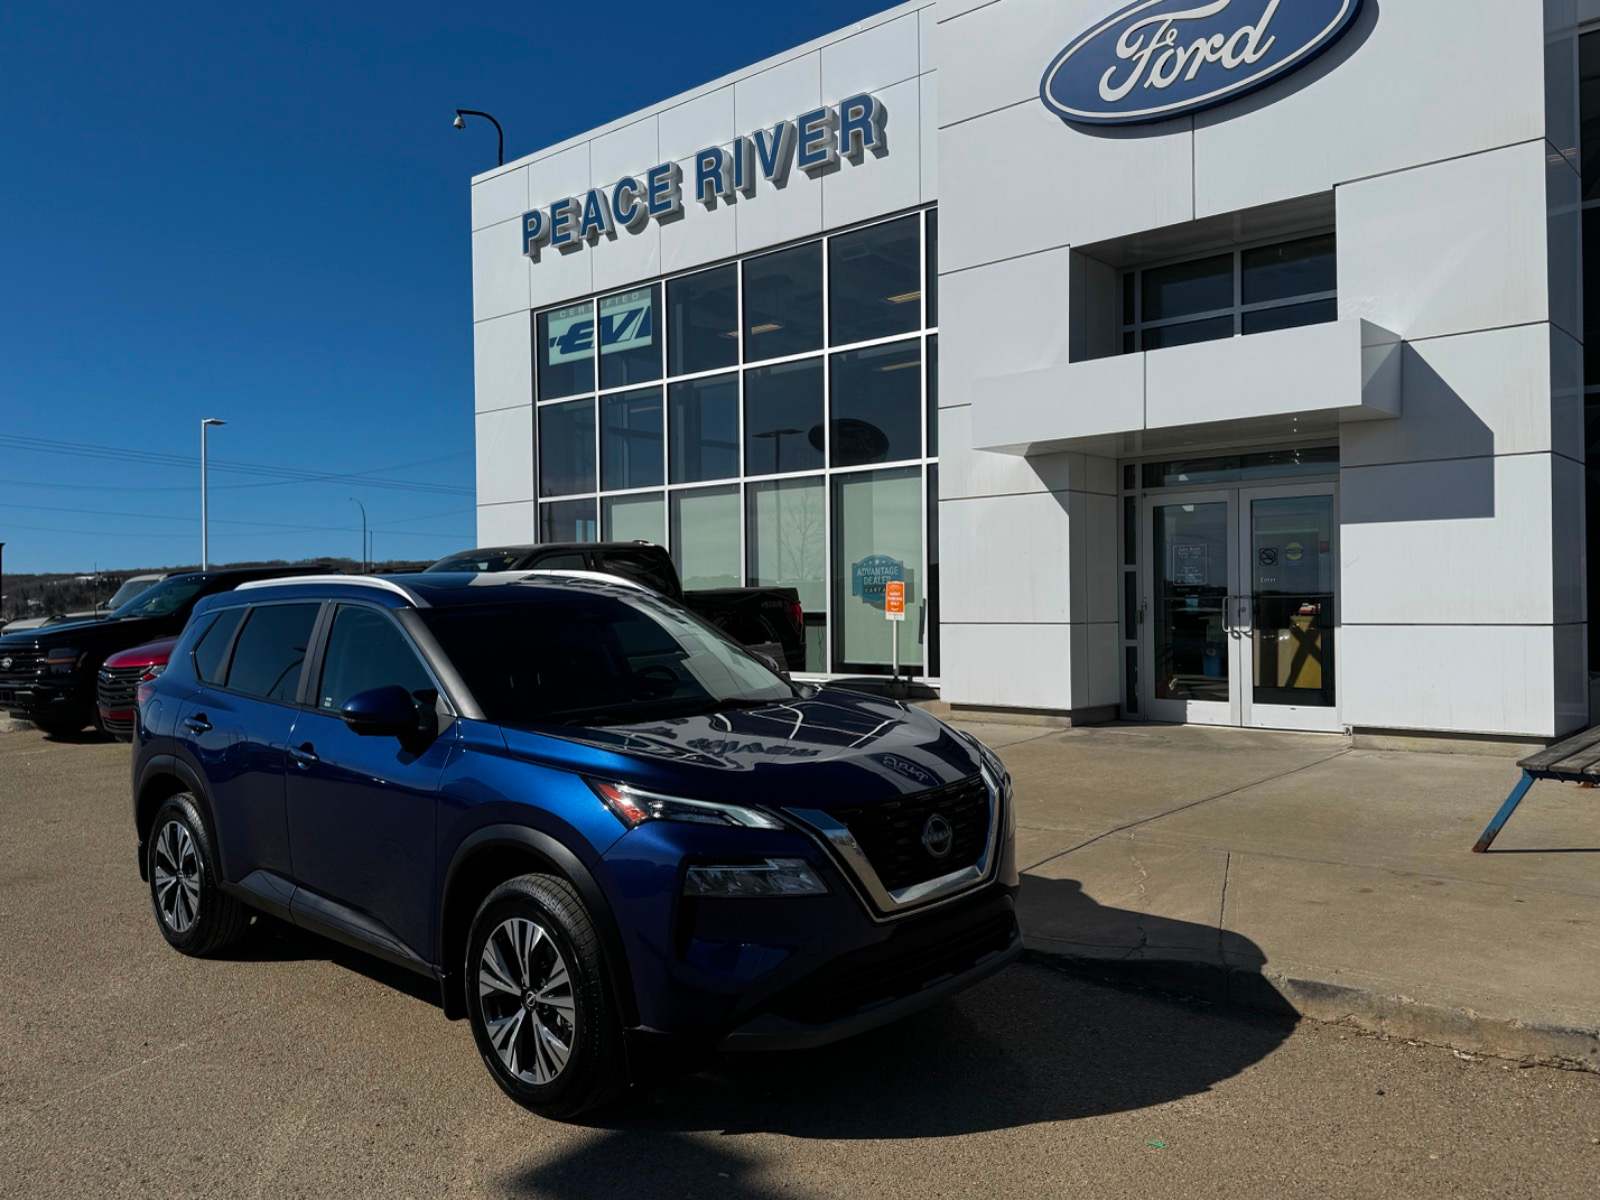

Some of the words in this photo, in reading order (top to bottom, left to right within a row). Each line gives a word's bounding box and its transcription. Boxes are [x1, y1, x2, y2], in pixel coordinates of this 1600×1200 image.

[1098, 0, 1281, 102] Ford
[522, 160, 684, 262] PEACE
[695, 92, 888, 208] RIVER
[856, 566, 899, 577] ADVANTAGE
